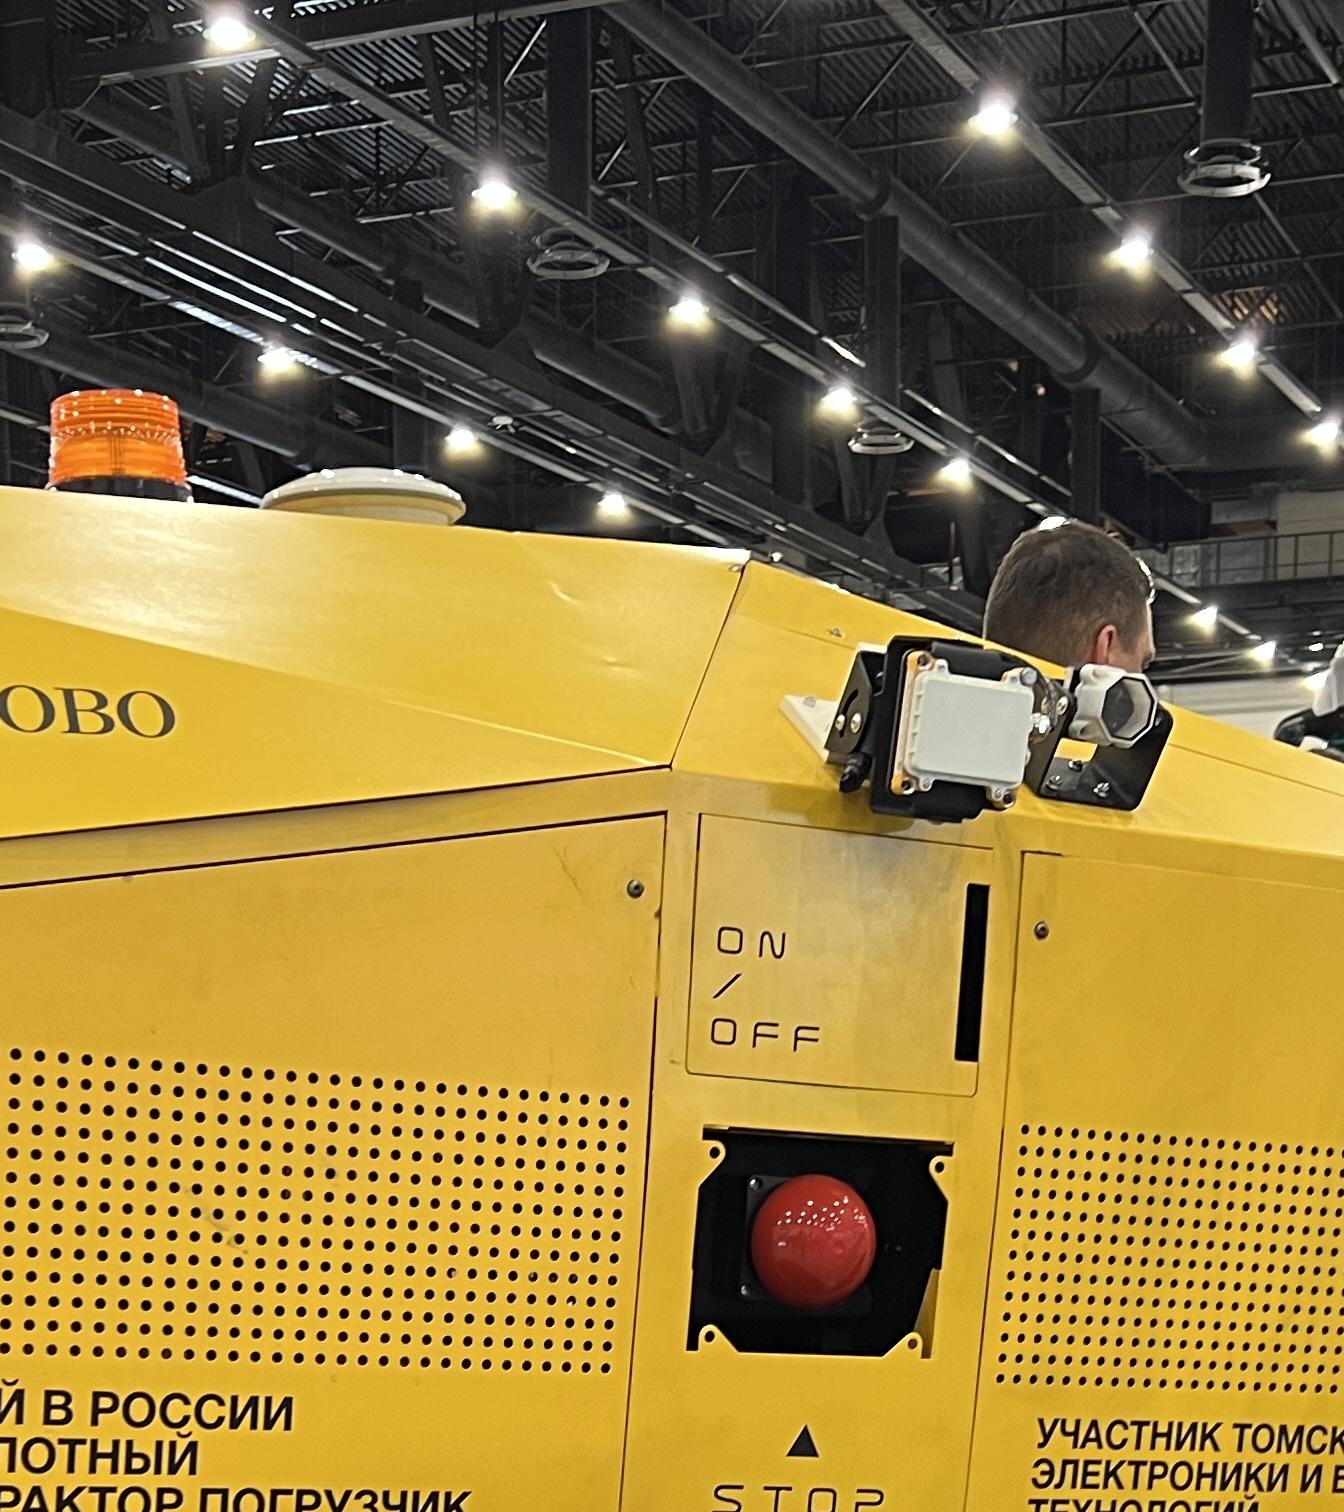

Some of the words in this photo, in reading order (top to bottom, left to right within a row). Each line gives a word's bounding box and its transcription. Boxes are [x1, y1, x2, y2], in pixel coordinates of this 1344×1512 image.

[717, 926, 786, 959] ON
[711, 1018, 820, 1052] OFF
[43, 1388, 73, 1425] В
[89, 1390, 294, 1431] РОССИИ
[1036, 1417, 1224, 1453] УЧАСТНИК
[1031, 1458, 1289, 1493] ЭЛЕКТРОНИКИ
[1298, 1464, 1322, 1494] И
